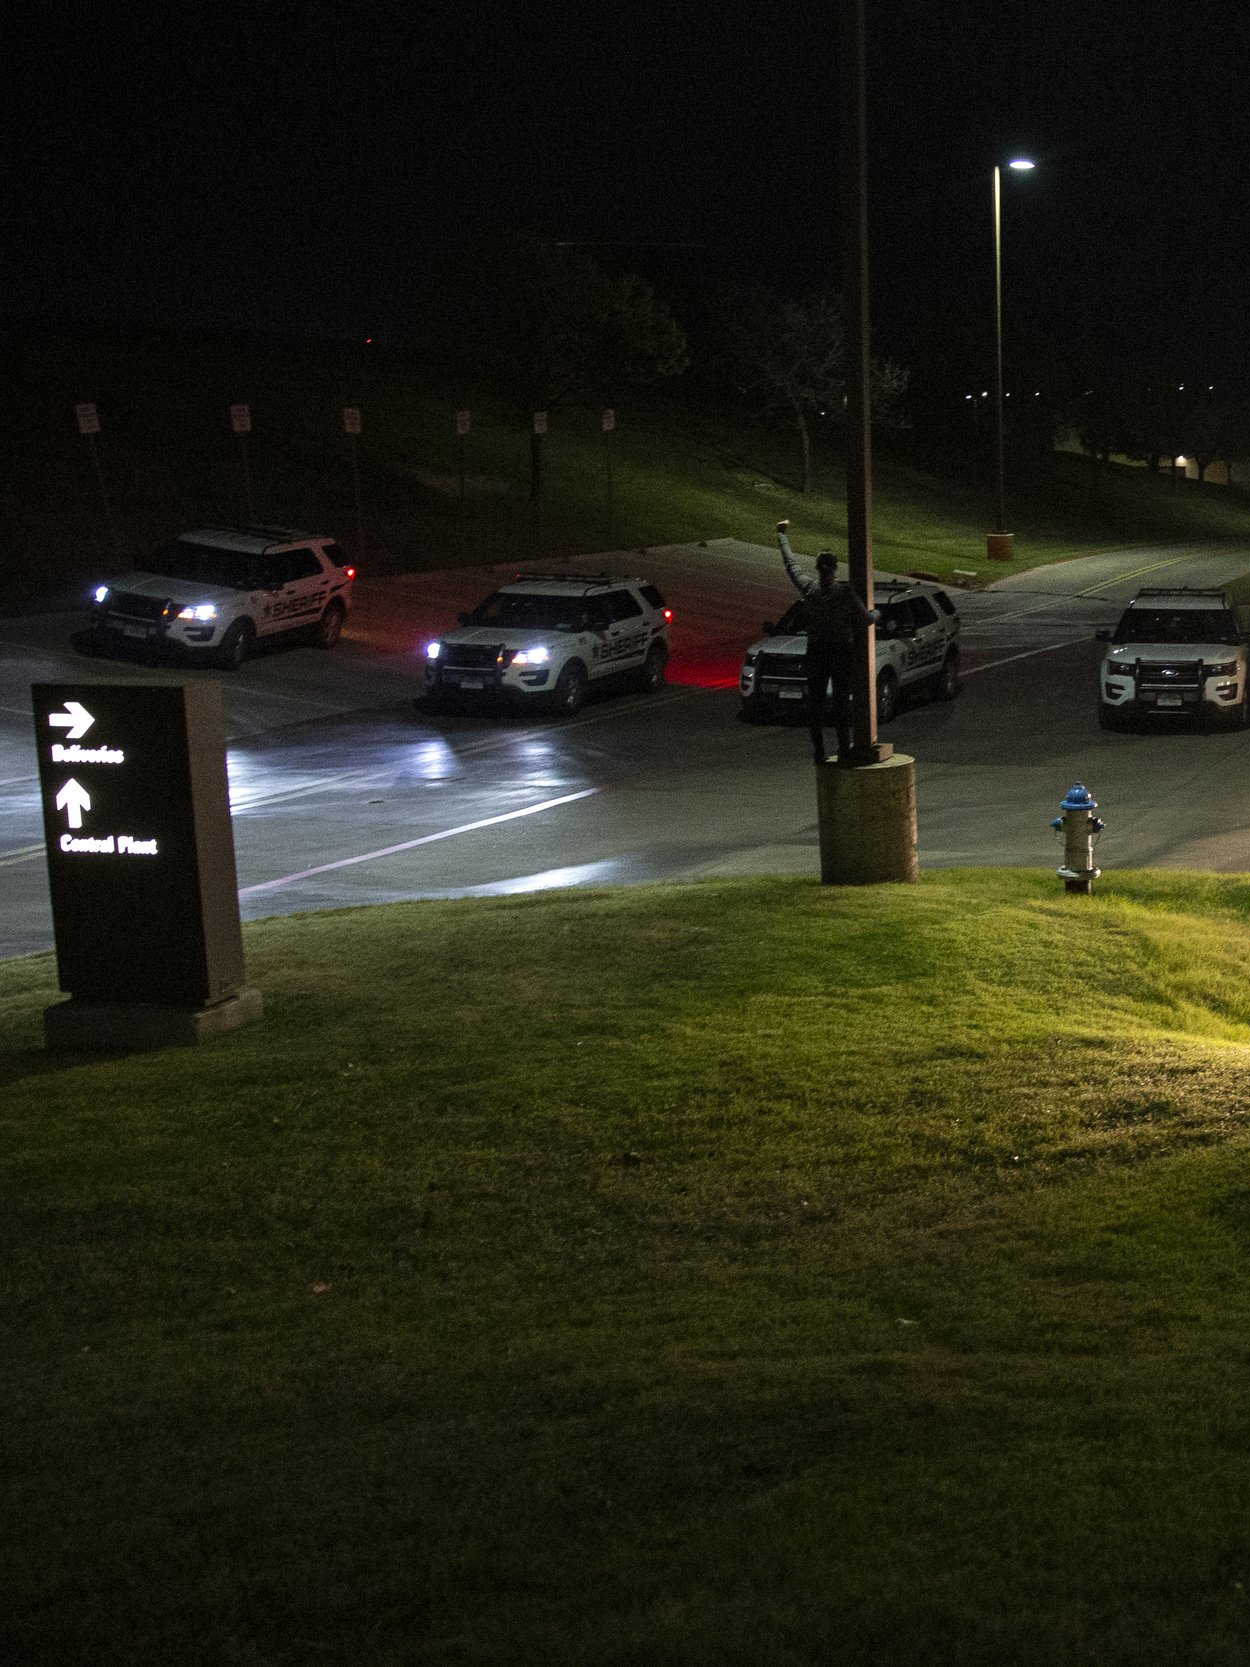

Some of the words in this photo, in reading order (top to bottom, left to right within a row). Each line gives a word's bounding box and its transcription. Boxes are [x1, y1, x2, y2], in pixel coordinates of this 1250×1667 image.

[272, 590, 326, 617] SHERIFF
[601, 632, 648, 659] SHERIFF
[60, 833, 115, 853] Central
[117, 836, 158, 855] Plant
